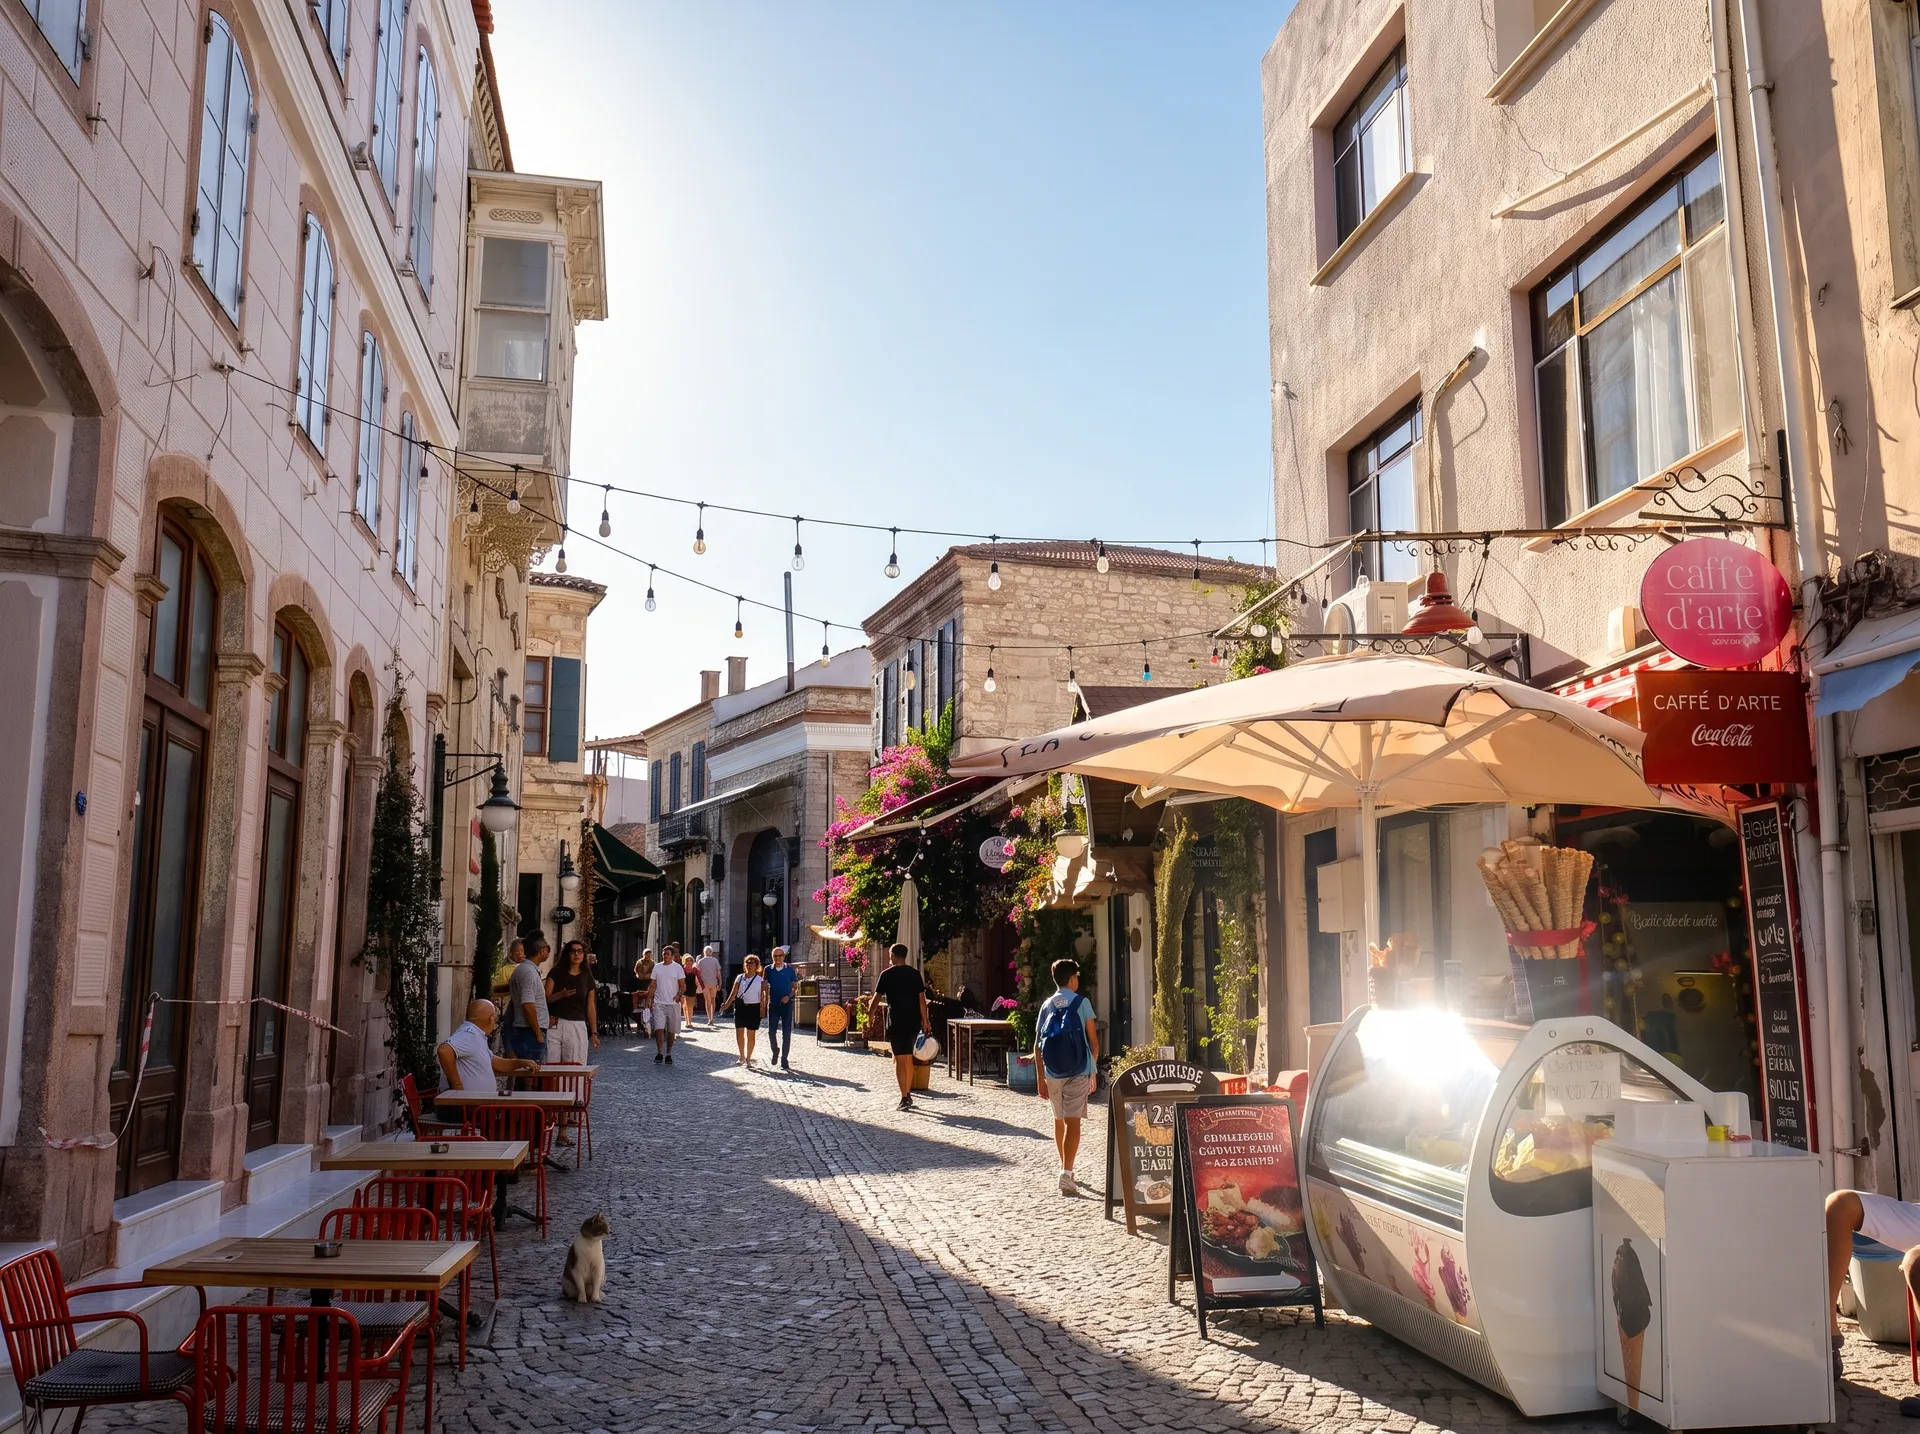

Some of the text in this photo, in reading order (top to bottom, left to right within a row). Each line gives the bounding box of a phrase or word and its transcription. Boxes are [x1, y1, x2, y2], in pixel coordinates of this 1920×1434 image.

[1666, 597, 1763, 630] d'arte
[1653, 690, 1782, 711] CAFFÉ D'ARTE
[1691, 723, 1755, 747] Coca-Cola
